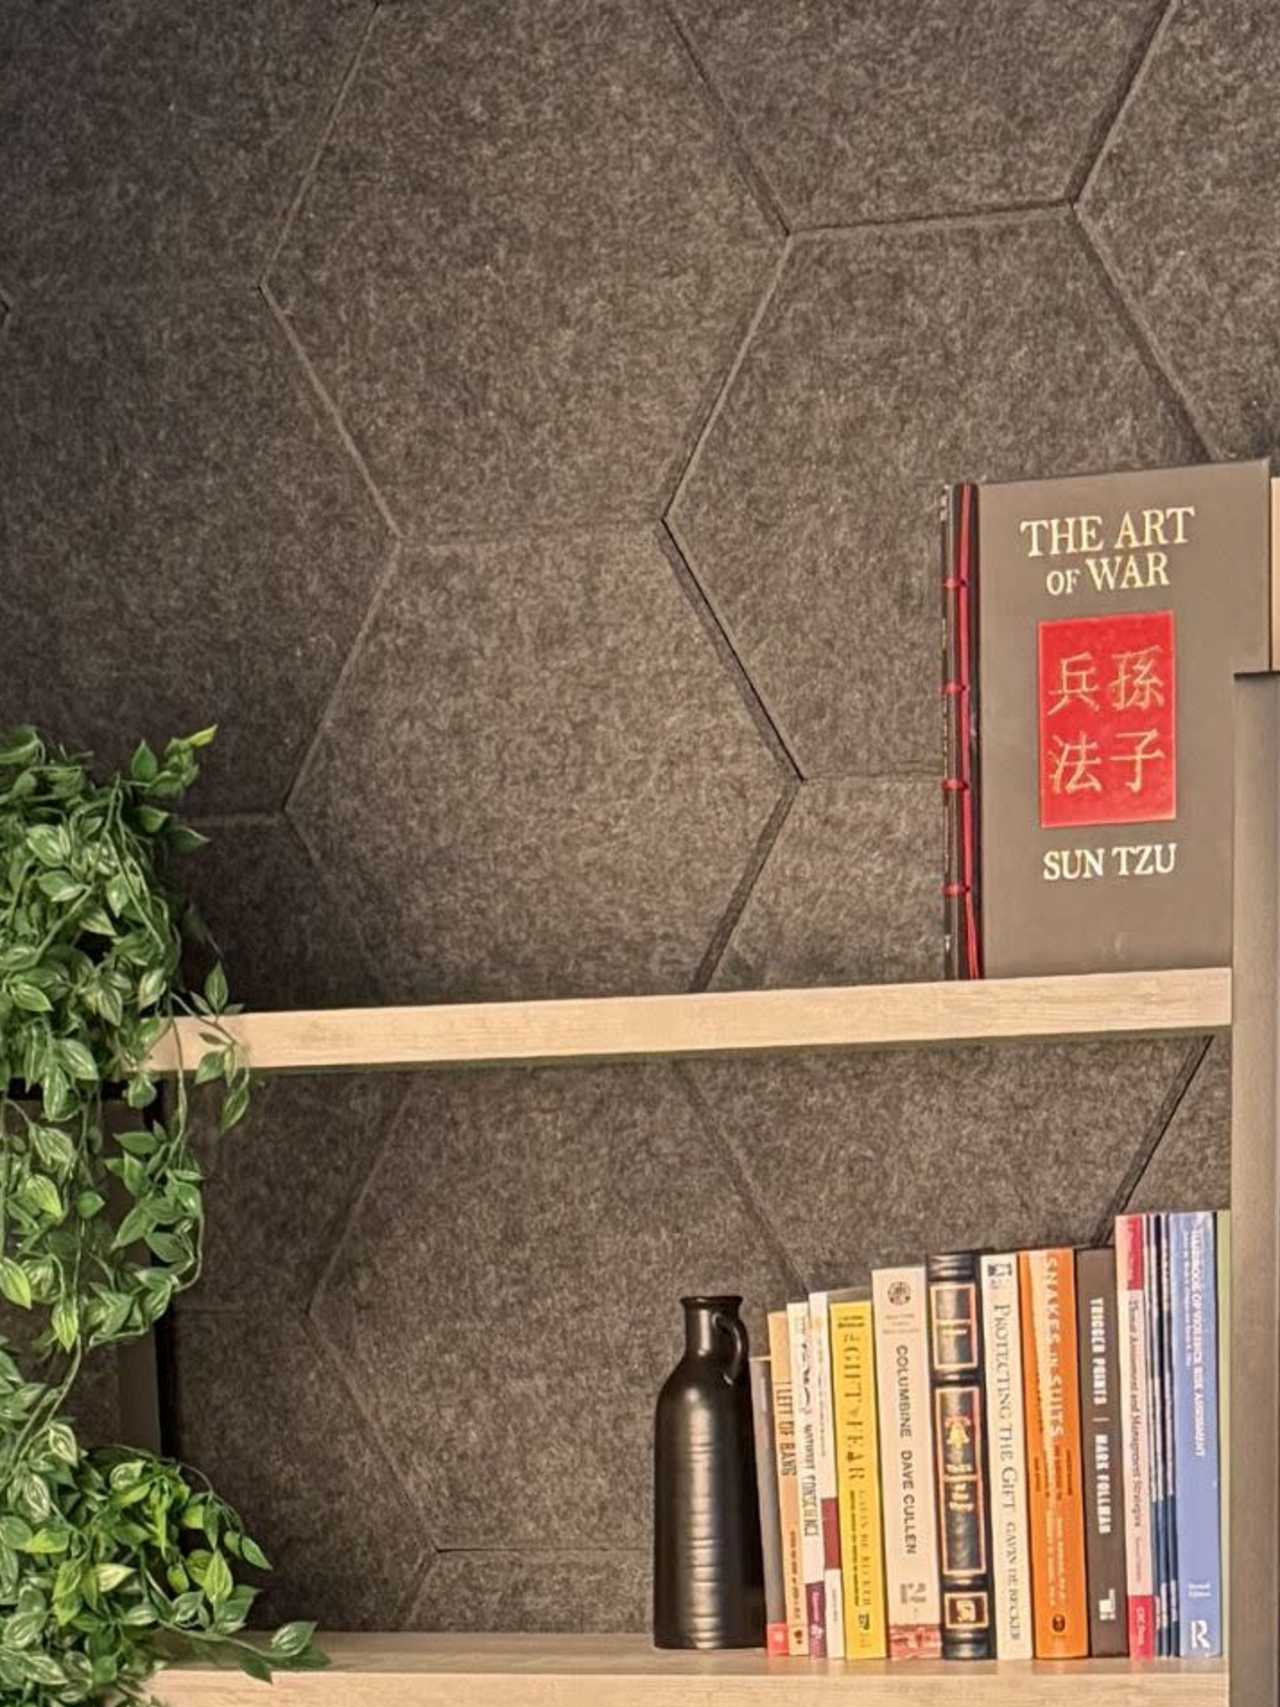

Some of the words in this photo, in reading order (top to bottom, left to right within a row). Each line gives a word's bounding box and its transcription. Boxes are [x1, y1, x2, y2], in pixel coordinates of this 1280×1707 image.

[1020, 515, 1104, 558] THE
[1114, 506, 1196, 549] ART
[1046, 568, 1081, 596] OF
[1085, 552, 1170, 592] WAR
[1043, 848, 1105, 881] SUN
[1111, 843, 1177, 877] TZU
[1044, 1257, 1063, 1344] SNAKES
[1090, 1297, 1106, 1353] TRIGGER
[994, 1304, 1013, 1419] PROTECTING
[1093, 1358, 1107, 1405] POINTS
[896, 1345, 912, 1438] COLUMBINE
[1048, 1375, 1064, 1438] SUITS
[999, 1424, 1014, 1462] THE
[1095, 1434, 1109, 1470] MARK
[901, 1451, 914, 1489] DAVE
[1001, 1467, 1019, 1512] GIFT
[903, 1494, 917, 1554] CULLEN
